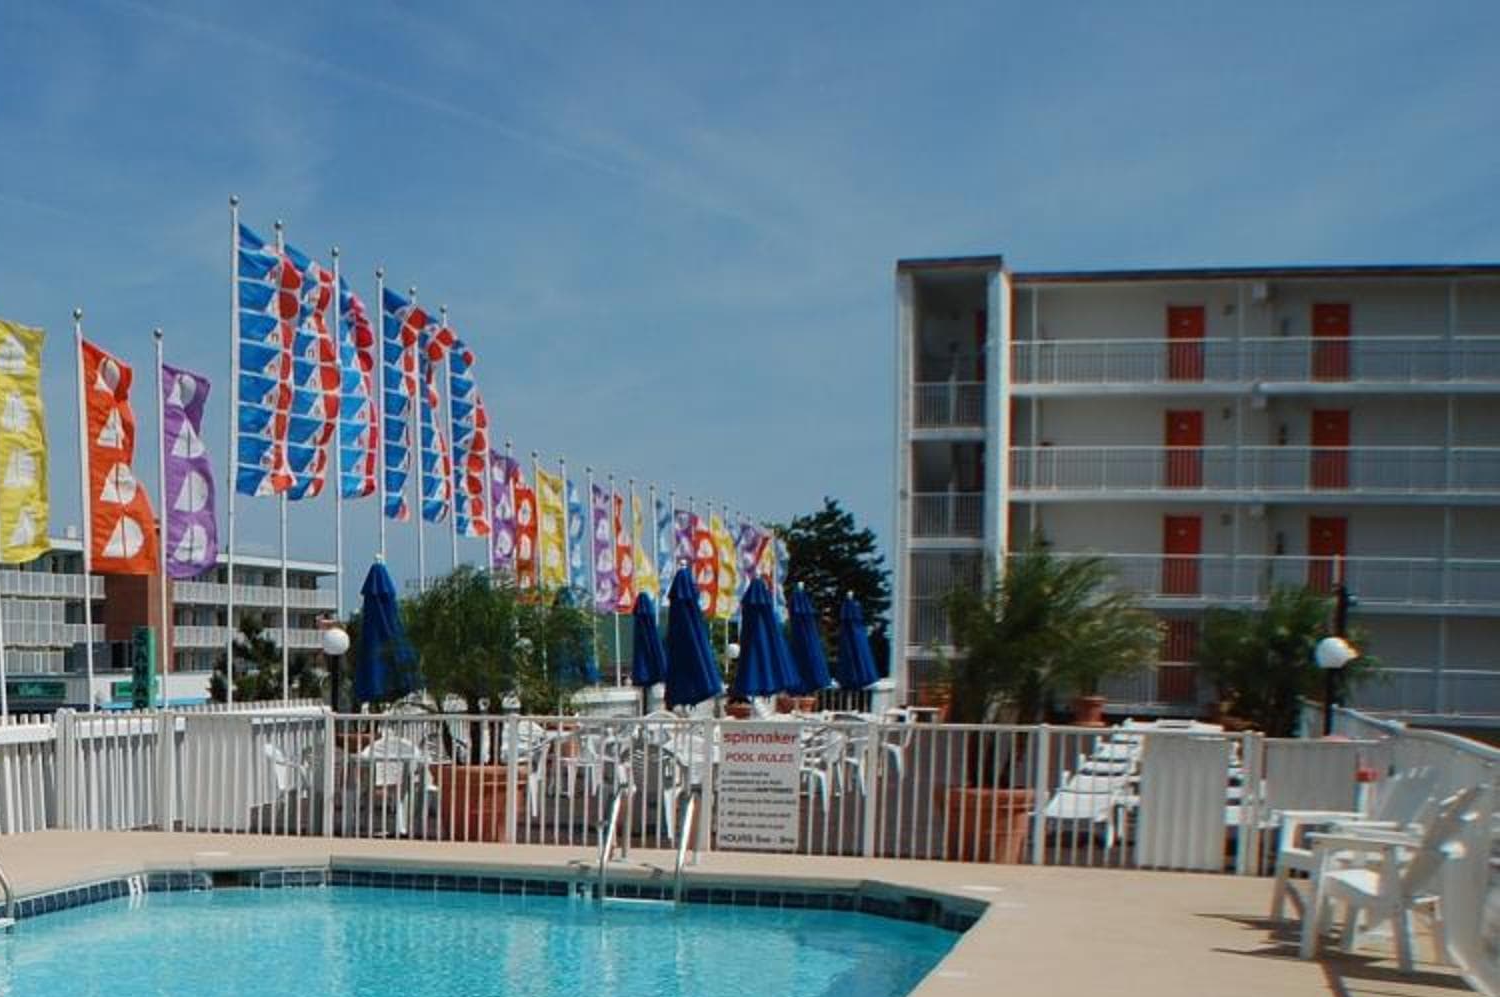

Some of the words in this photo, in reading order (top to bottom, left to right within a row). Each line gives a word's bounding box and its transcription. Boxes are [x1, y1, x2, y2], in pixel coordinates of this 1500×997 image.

[723, 729, 798, 746] spinnaker
[725, 752, 754, 763] POOL
[757, 752, 794, 763] RULES
